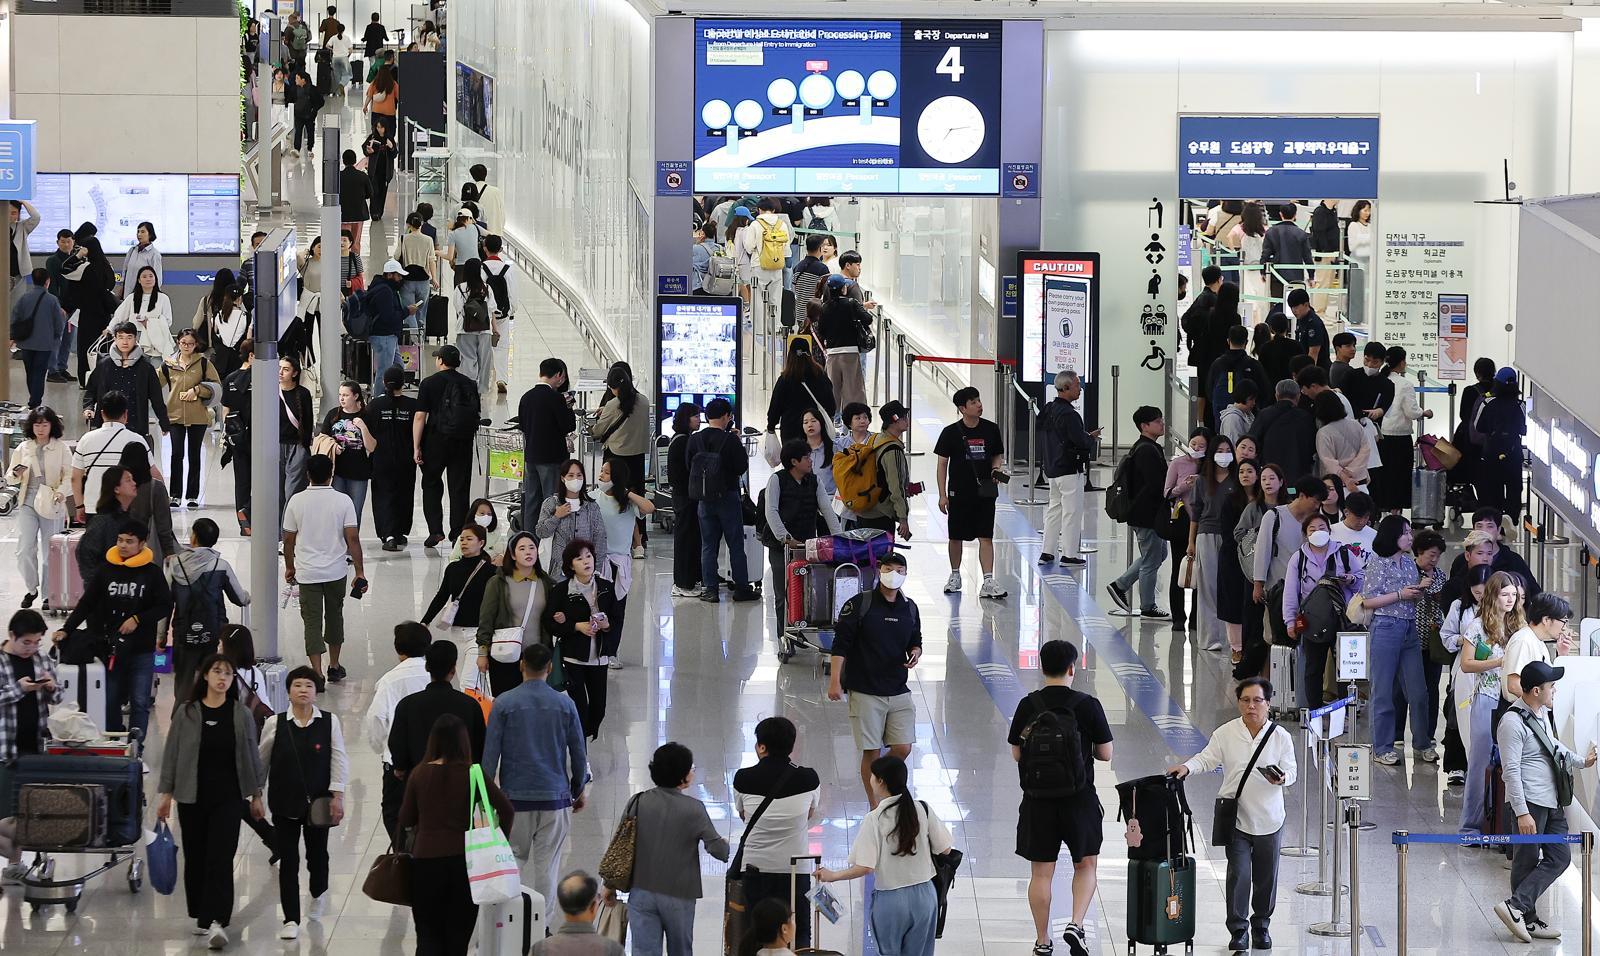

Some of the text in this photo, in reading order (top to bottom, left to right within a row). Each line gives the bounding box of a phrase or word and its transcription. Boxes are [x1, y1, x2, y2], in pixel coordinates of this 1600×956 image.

[818, 29, 867, 41] Processing
[868, 29, 892, 40] Time
[914, 29, 941, 40] 출국장
[944, 32, 990, 40] Departure Hall
[935, 46, 965, 82] 4
[1188, 141, 1220, 155] 승무원
[1230, 141, 1274, 155] 도심공항
[1386, 233, 1426, 241] 다자녀 가구
[1386, 248, 1408, 257] 승무원
[1424, 248, 1446, 258] 외교관
[1033, 262, 1084, 273] CAUTION
[1386, 269, 1463, 278] 도심공항터미널 이용객
[1385, 290, 1433, 299] 보행상 장애인
[1051, 306, 1070, 314] boarding
[1385, 311, 1407, 320] 고령자
[1422, 311, 1437, 320] 유소
[1384, 332, 1406, 341] 임신부
[1422, 332, 1437, 341] 병약
[1410, 353, 1438, 362] 우대카드
[1489, 835, 1511, 843] 우리은행
